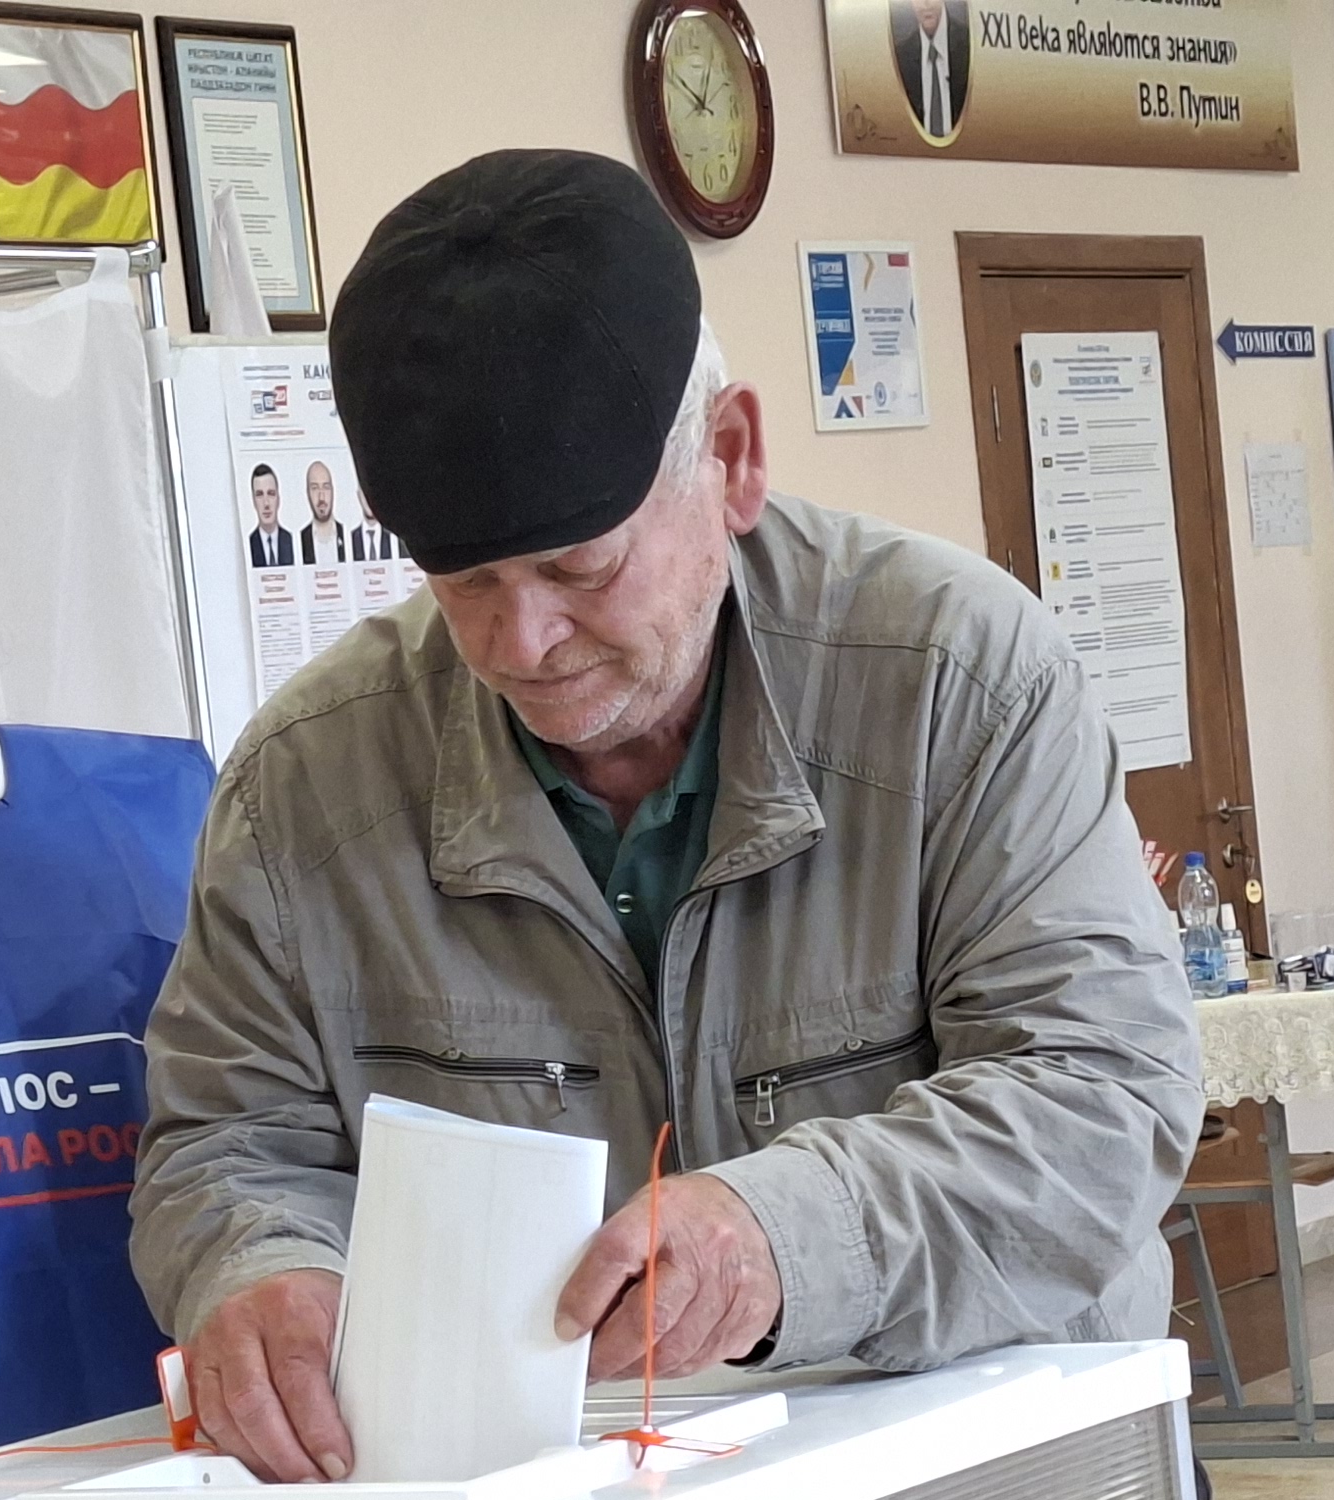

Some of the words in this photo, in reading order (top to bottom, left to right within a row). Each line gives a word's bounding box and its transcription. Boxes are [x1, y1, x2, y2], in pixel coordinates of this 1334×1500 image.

[979, 11, 1012, 49] XXI
[1017, 14, 1061, 53] века
[1067, 19, 1161, 60] являются
[1166, 35, 1238, 64] знания»
[1139, 82, 1175, 118] В.В.
[1179, 85, 1240, 128] Путин
[1234, 330, 1314, 353] КОМИССИЯ
